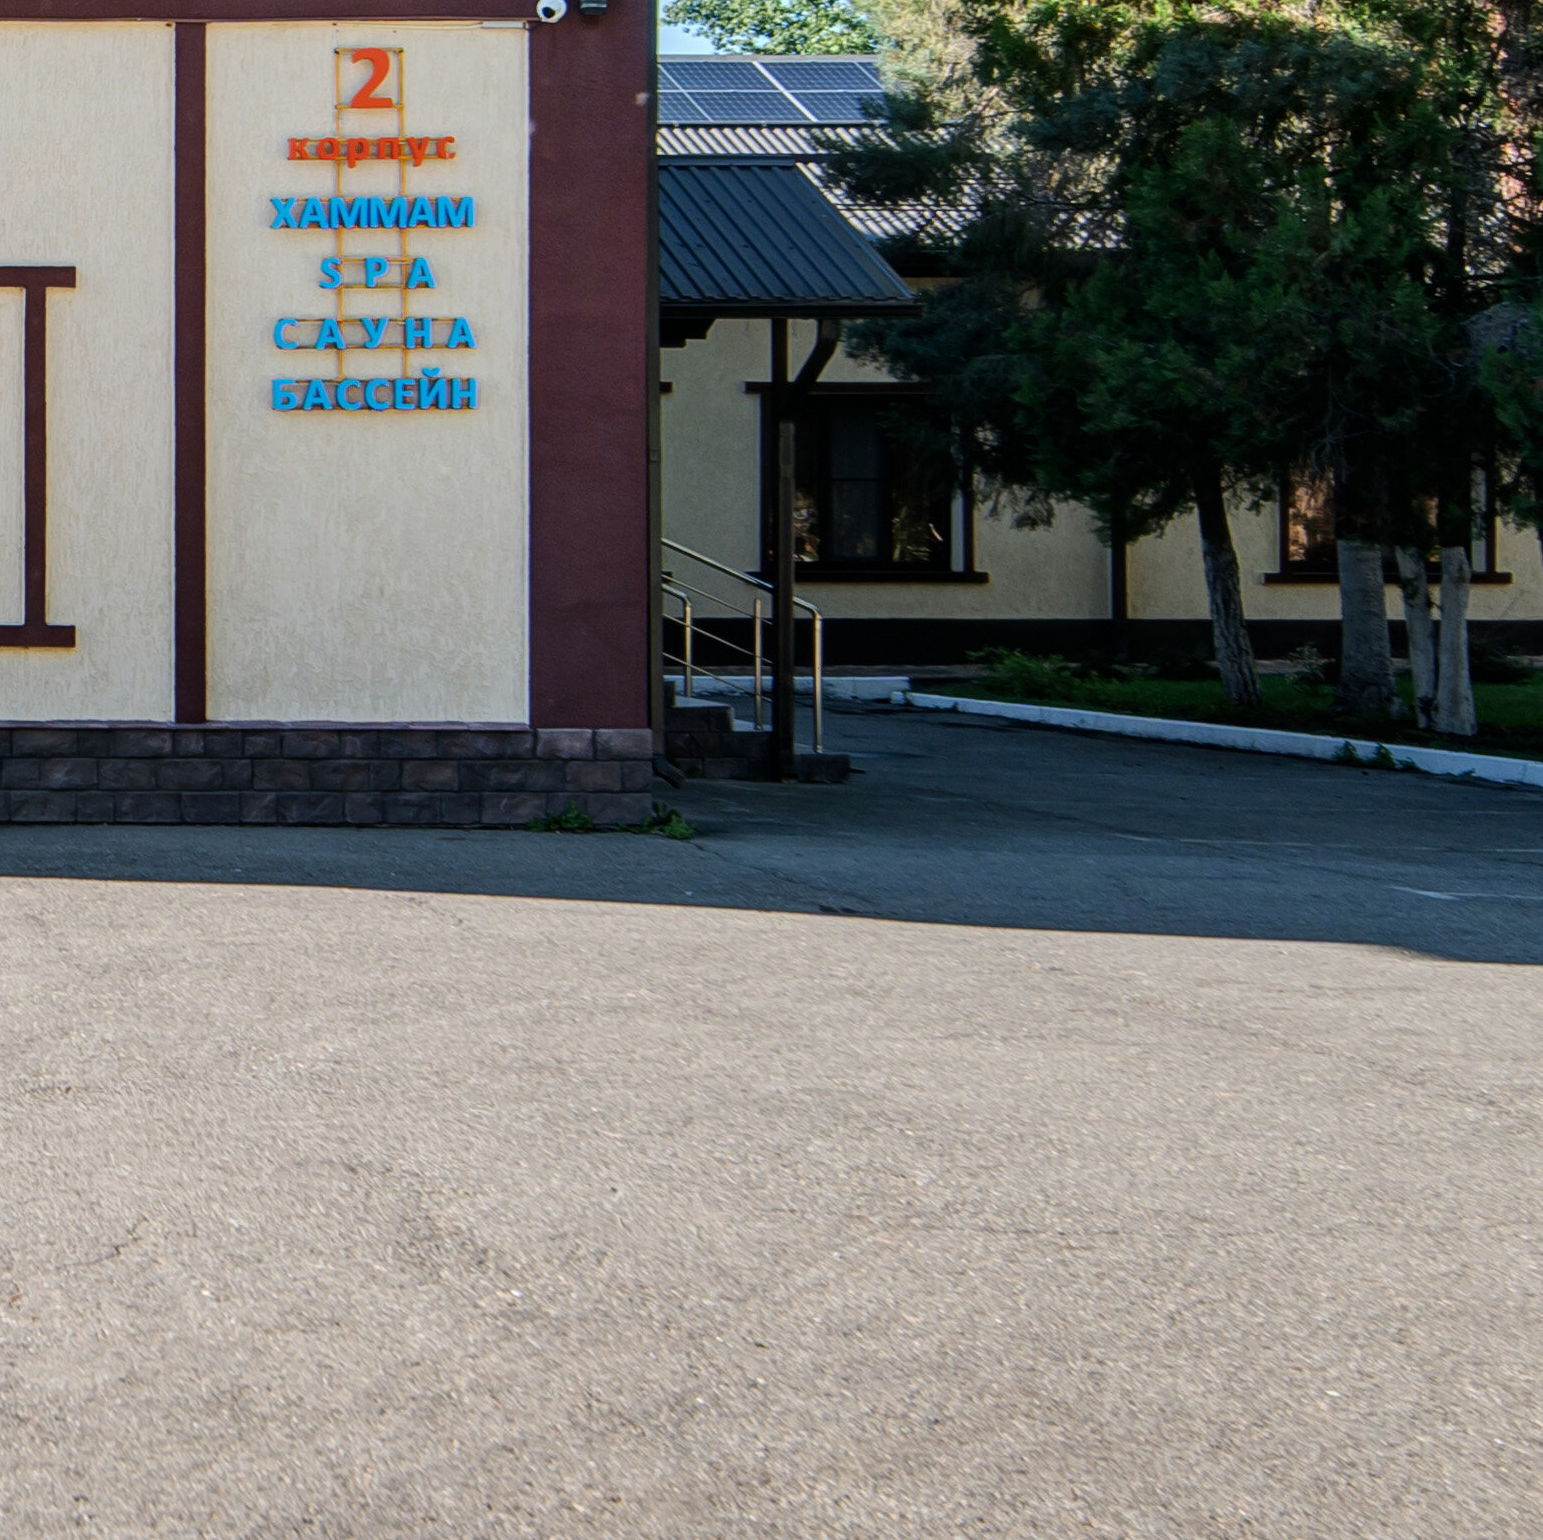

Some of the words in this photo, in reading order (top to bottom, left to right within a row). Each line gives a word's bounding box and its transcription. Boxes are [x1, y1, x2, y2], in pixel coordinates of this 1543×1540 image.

[350, 47, 393, 108] 2
[288, 136, 456, 168] корпус
[270, 196, 476, 228] ХАММАМ
[319, 257, 436, 288] SPA
[273, 317, 476, 349] САУНА
[272, 367, 478, 410] БАССЕЙН
